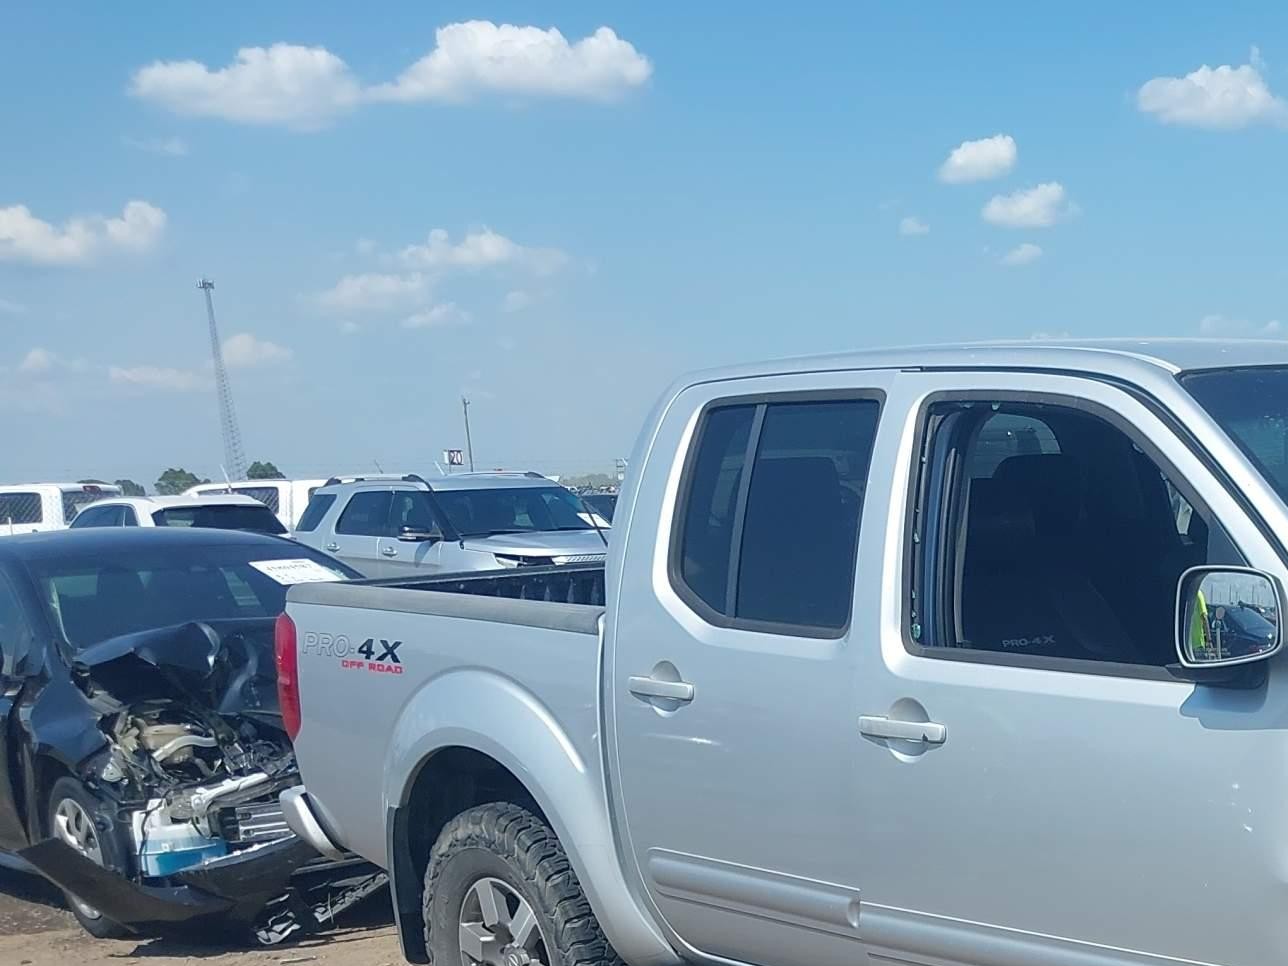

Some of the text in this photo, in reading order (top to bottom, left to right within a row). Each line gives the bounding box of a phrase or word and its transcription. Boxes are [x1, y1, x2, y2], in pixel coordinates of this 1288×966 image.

[302, 631, 403, 663] PRO-4X
[1002, 634, 1056, 648] PRO-4X
[341, 659, 403, 674] OFF ROAD
